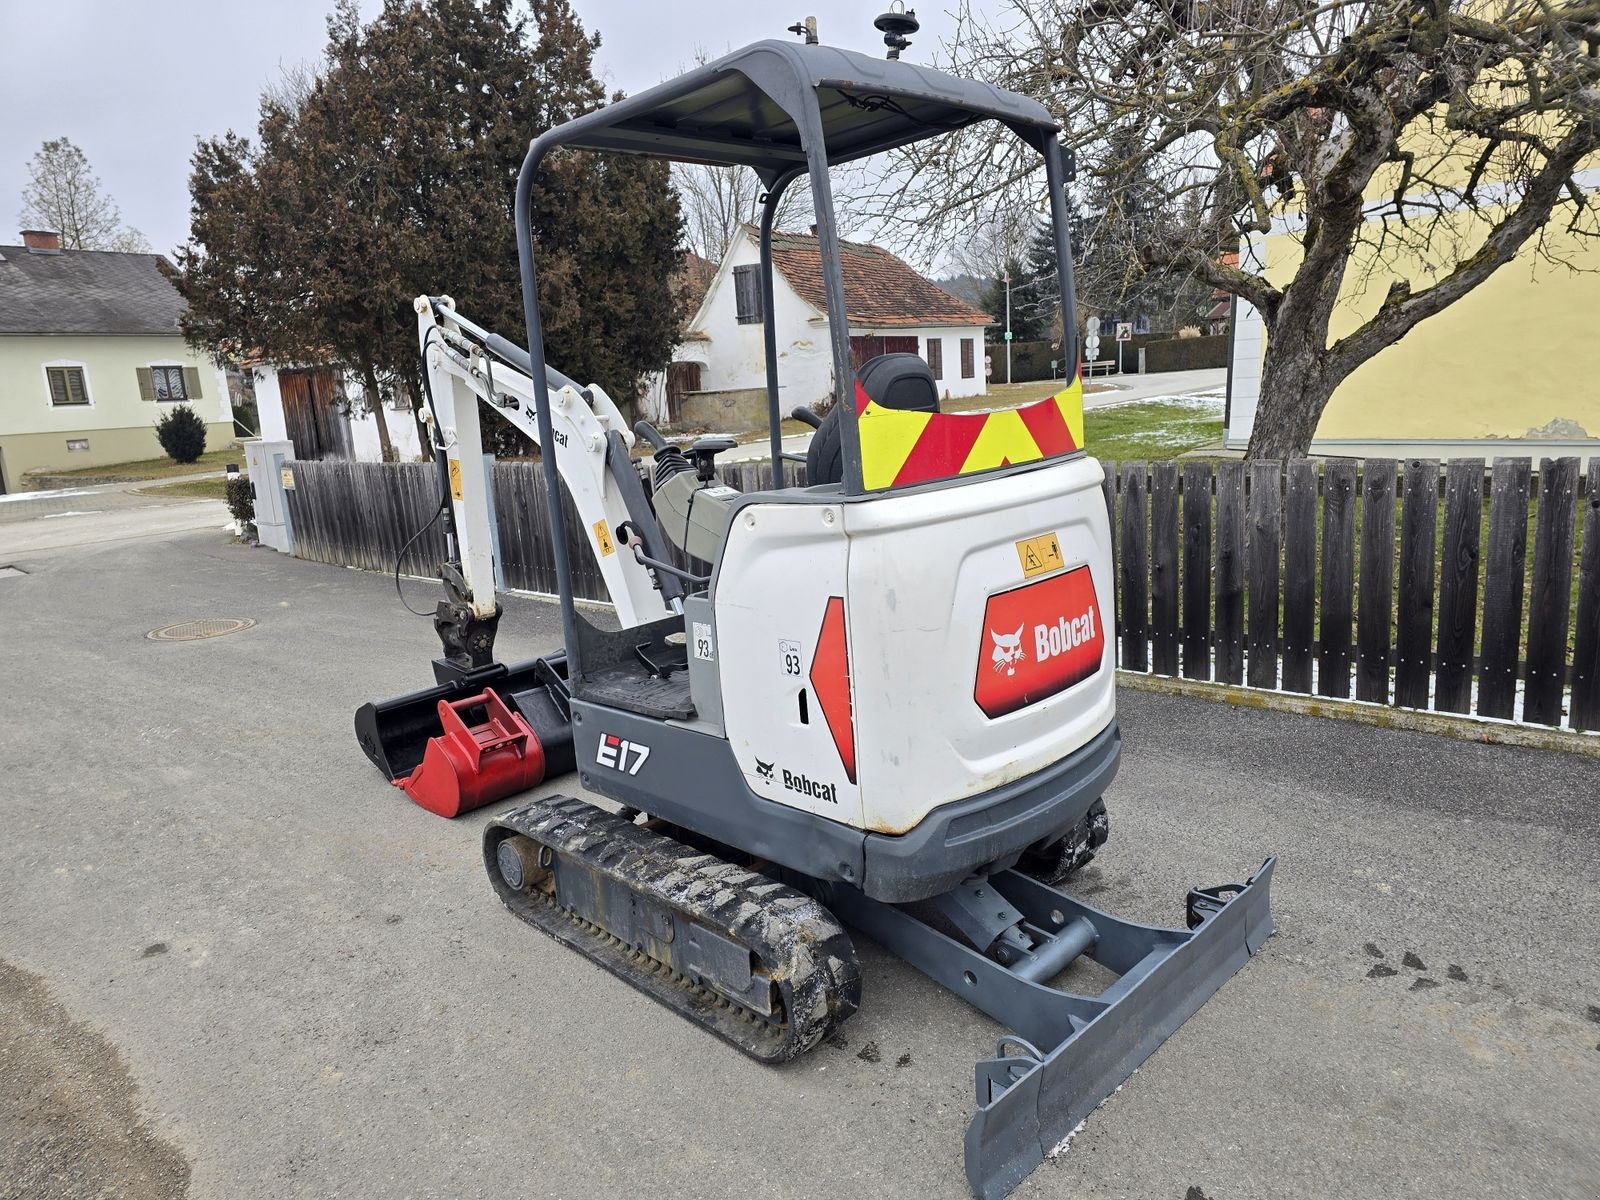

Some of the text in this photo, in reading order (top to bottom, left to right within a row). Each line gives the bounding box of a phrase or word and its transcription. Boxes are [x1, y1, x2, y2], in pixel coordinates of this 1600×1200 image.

[698, 639, 709, 657] 93
[1034, 605, 1095, 662] Bobcat
[785, 653, 801, 675] 93
[596, 732, 650, 776] E17
[782, 768, 838, 805] Bobcat
